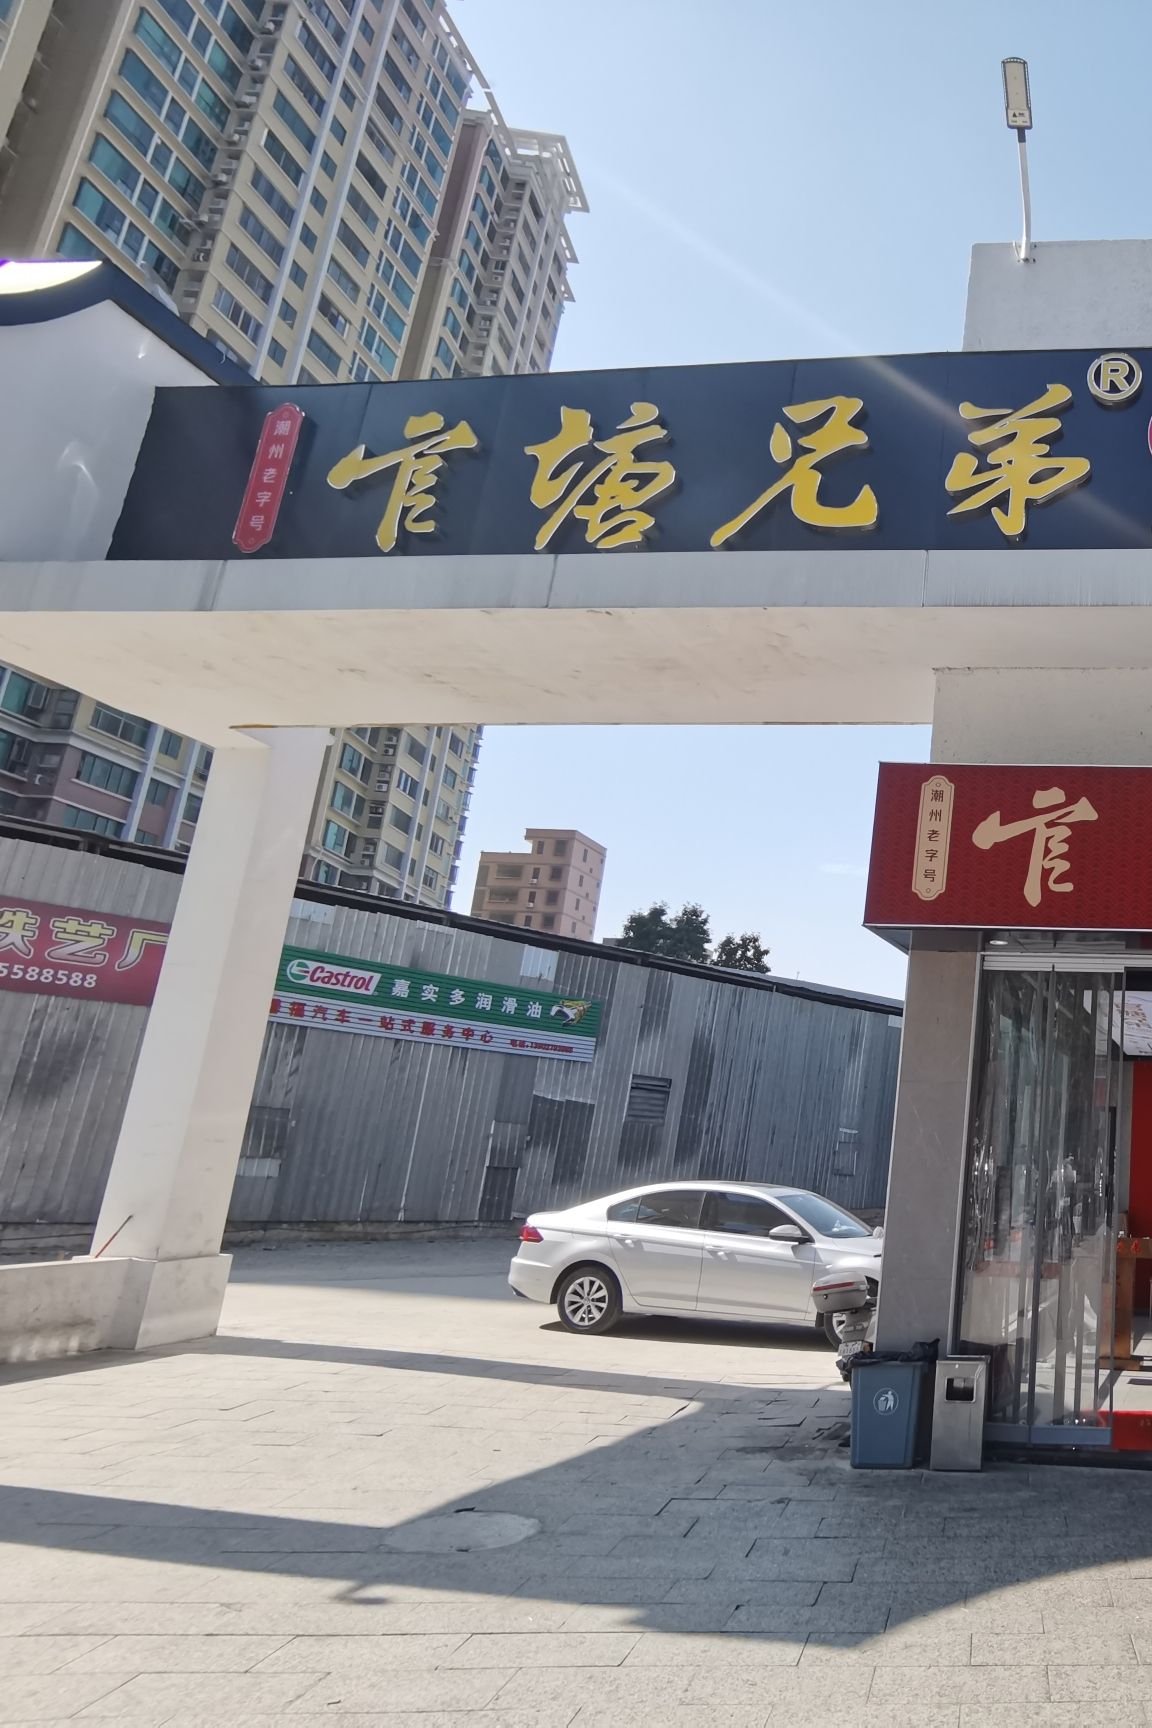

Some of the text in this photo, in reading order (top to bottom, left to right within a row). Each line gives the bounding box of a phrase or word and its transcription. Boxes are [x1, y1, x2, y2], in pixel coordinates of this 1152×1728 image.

[247, 420, 292, 531] 潮州老字号
[327, 384, 1090, 552] 官塘兄弟
[922, 789, 944, 883] 潮州老字号
[309, 965, 543, 1019] Castrol 嘉实多润滑油
